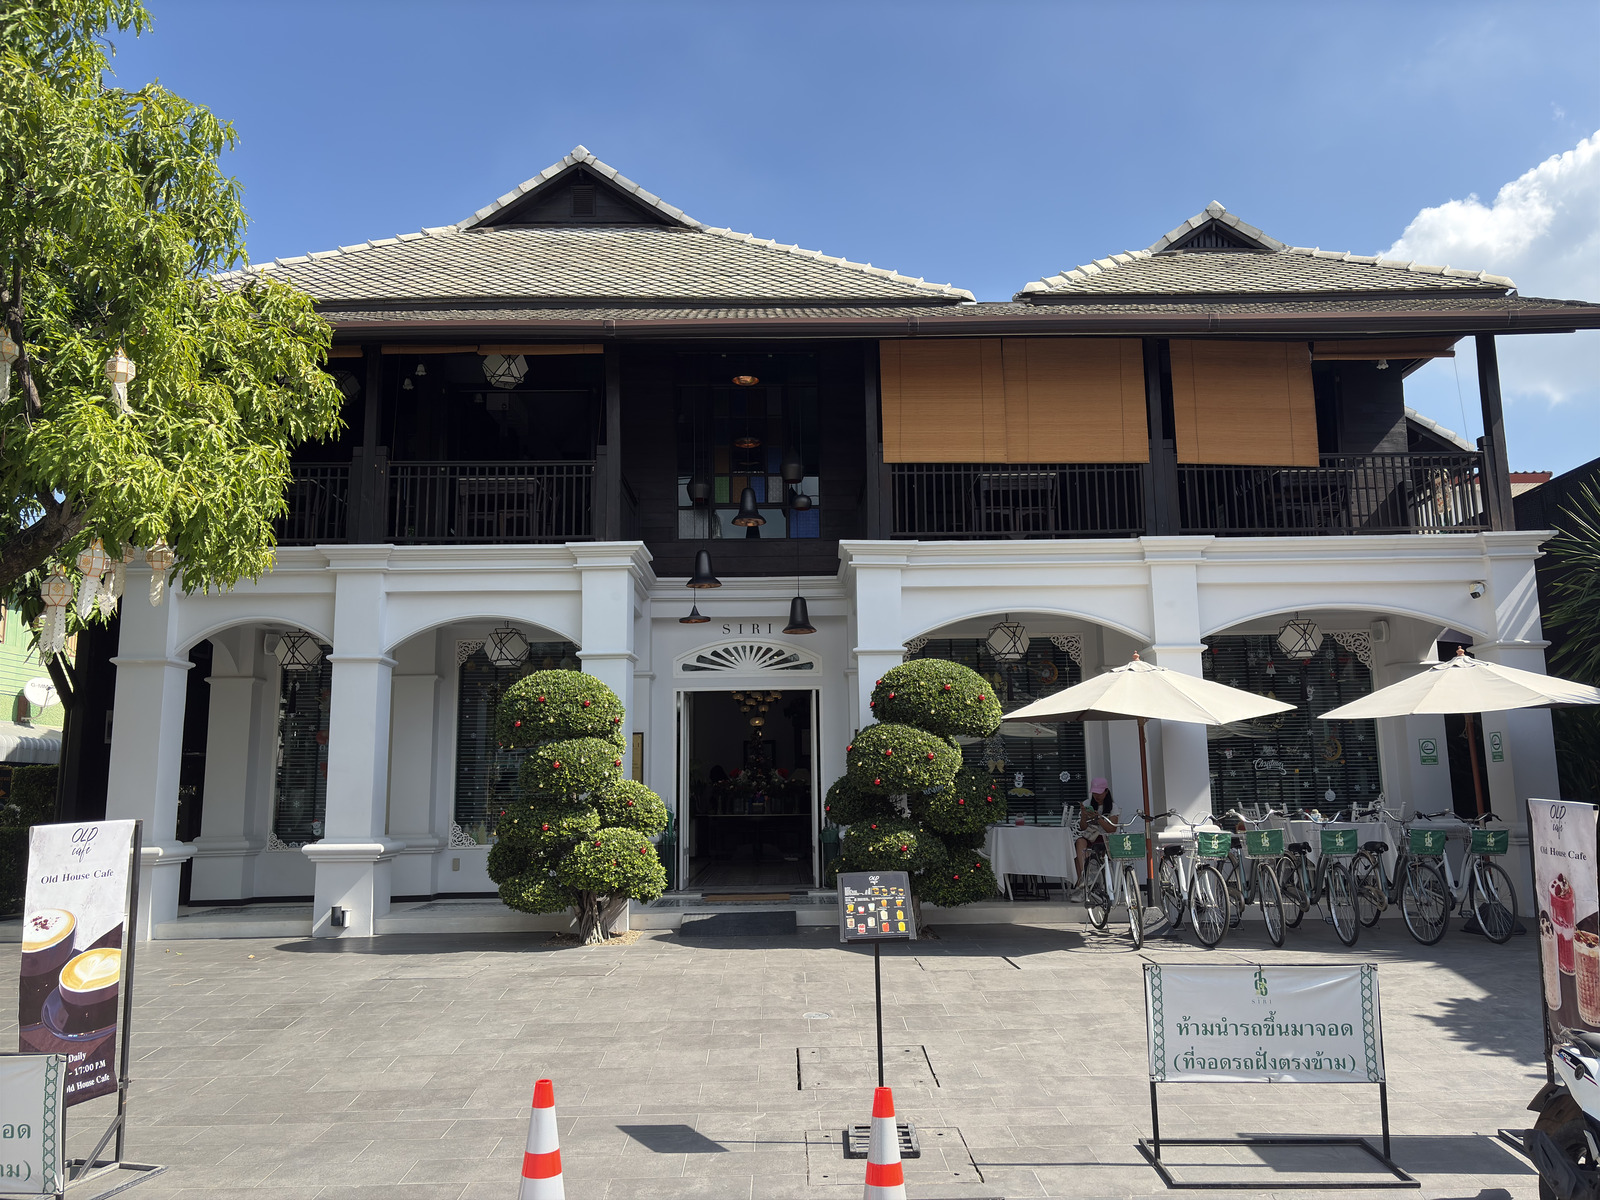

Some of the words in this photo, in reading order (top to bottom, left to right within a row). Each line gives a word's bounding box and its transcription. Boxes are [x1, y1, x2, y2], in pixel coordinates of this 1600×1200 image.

[722, 623, 772, 634] SIRI
[1549, 804, 1567, 820] OLD
[71, 826, 99, 843] OLD
[1550, 847, 1567, 858] House
[1568, 850, 1587, 861] Cafe
[40, 874, 59, 885] Old
[62, 872, 91, 883] House
[93, 868, 114, 879] Cafe
[1176, 1010, 1353, 1037] ห้ามนำรถขึ้นมาจอด
[68, 1051, 87, 1064] Daily
[1173, 1046, 1357, 1073] (ที่จอดรถฝั่งตรงข้าม)
[74, 1063, 94, 1076] 17:00
[76, 1079, 95, 1091] House
[95, 1073, 111, 1084] Cafe
